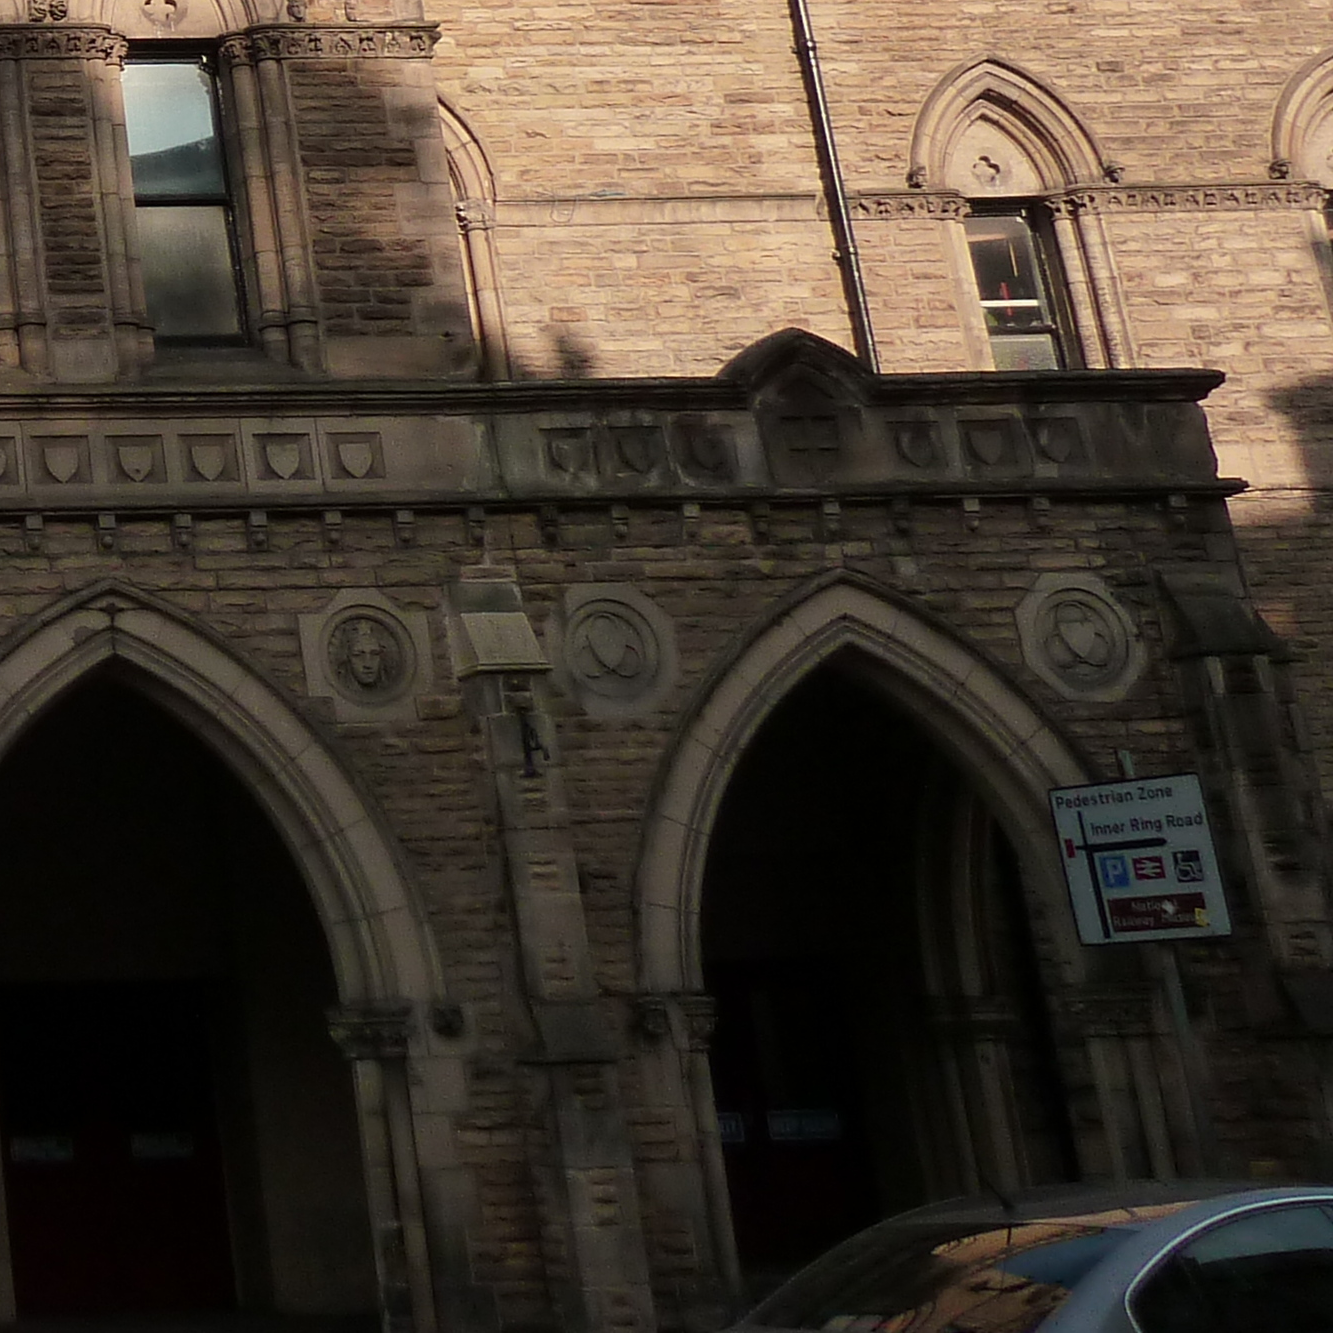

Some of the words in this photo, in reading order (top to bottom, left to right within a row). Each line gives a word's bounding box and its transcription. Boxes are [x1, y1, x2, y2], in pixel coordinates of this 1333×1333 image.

[1055, 790, 1133, 809] Pedestrian
[1136, 786, 1173, 801] Zone
[1090, 821, 1125, 836] Inner
[1129, 816, 1163, 832] Ring
[1165, 812, 1204, 828] Road
[1106, 859, 1122, 884] P
[1131, 898, 1180, 912] Natiol
[1113, 915, 1155, 928] Railway
